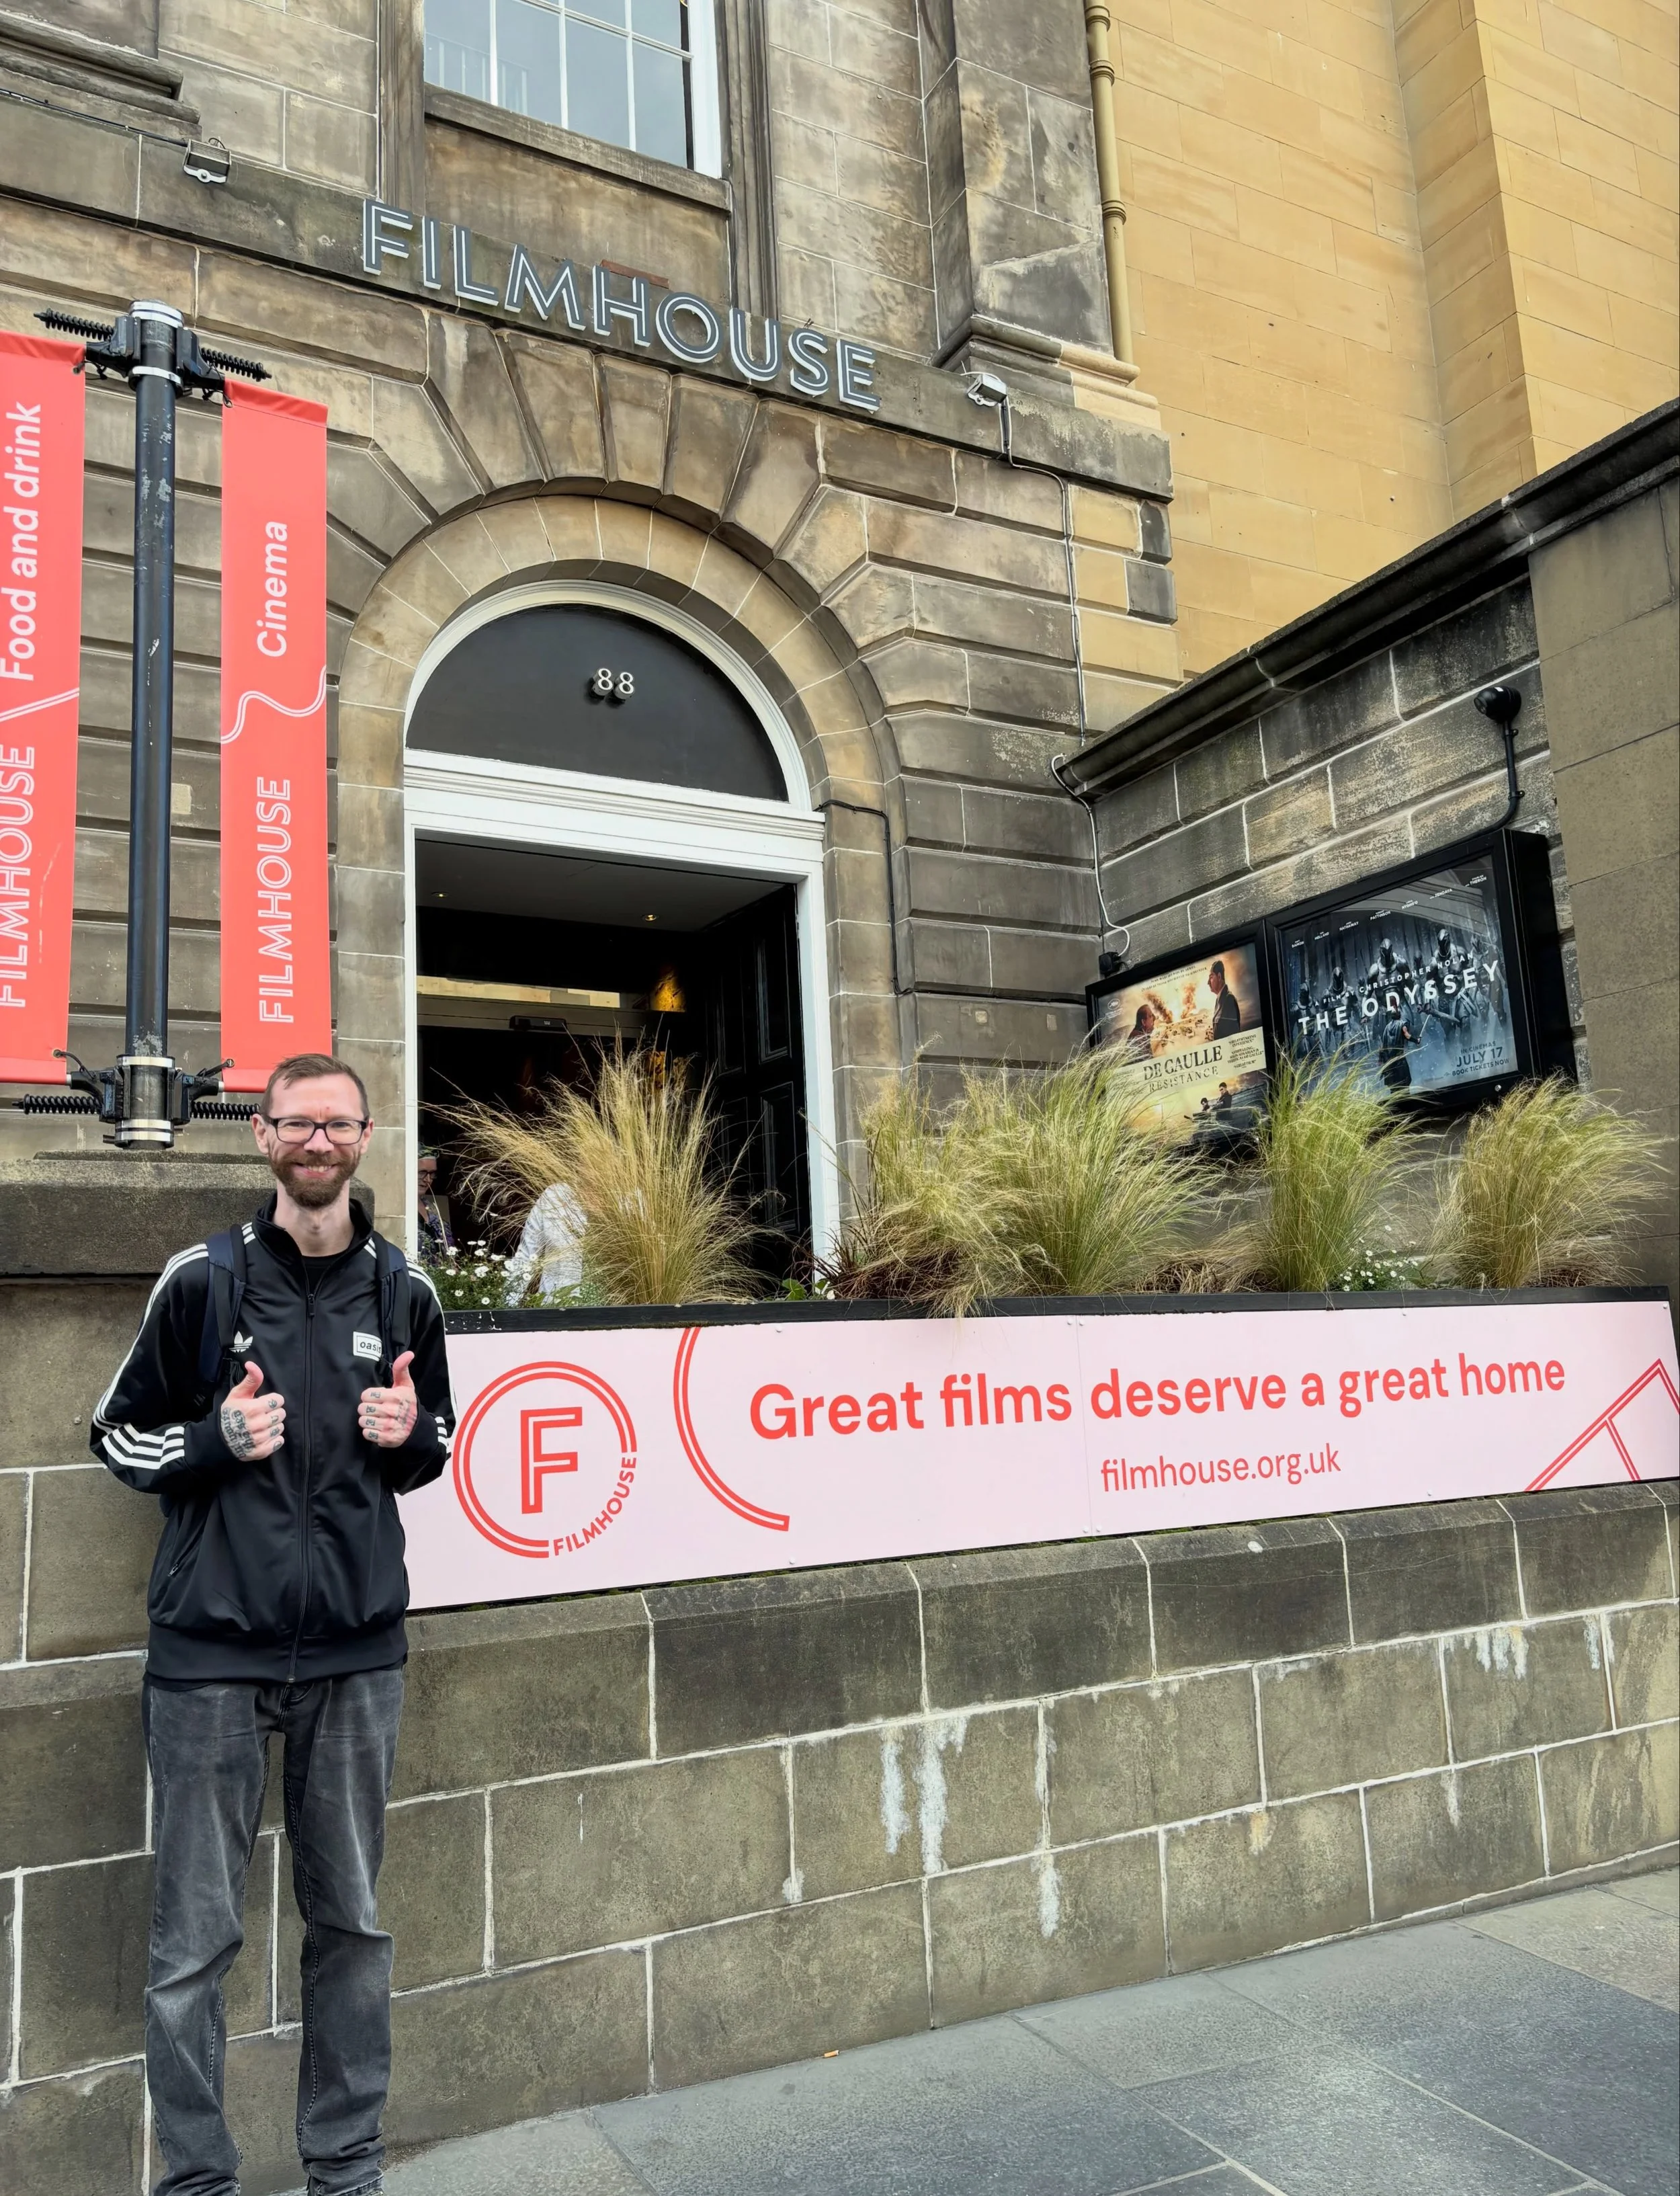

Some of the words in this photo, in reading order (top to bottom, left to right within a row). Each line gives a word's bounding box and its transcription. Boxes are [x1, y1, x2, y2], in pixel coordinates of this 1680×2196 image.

[363, 198, 880, 412] FILMHOUSE
[4, 402, 41, 498] drink
[3, 506, 39, 579] and
[256, 521, 288, 657] Cinema
[0, 587, 36, 680] Food
[597, 668, 634, 694] 88
[0, 744, 35, 1008] FILMHOUSE
[255, 776, 294, 1023] FILMHOUSE
[1298, 1006, 1348, 1035] THE
[1363, 960, 1499, 1017] ODYSSEY
[1323, 994, 1341, 1004] FILM
[1359, 966, 1431, 993] CHRISTOPHER
[1437, 952, 1474, 969] NOLAN
[1143, 1063, 1162, 1080] DE
[1165, 1046, 1222, 1074] GAULLE
[1149, 1066, 1218, 1092] RESISTANCE
[1452, 1068, 1468, 1076] BOOK
[1470, 1063, 1493, 1071] TICKETS
[1457, 1051, 1486, 1067] JULY
[1491, 1047, 1503, 1059] 17
[1469, 1041, 1497, 1052] CINEMAS
[360, 1342, 381, 1354] oasis
[750, 1383, 925, 1440] Great
[940, 1373, 1072, 1428] films
[1091, 1368, 1286, 1420] deserve
[1301, 1373, 1325, 1408] a
[1339, 1358, 1449, 1418] great
[1459, 1352, 1565, 1396] home
[520, 1406, 583, 1514] F
[1101, 1443, 1341, 1492] filmhouse.org.uk
[554, 1457, 637, 1556] FILMHOUSE
